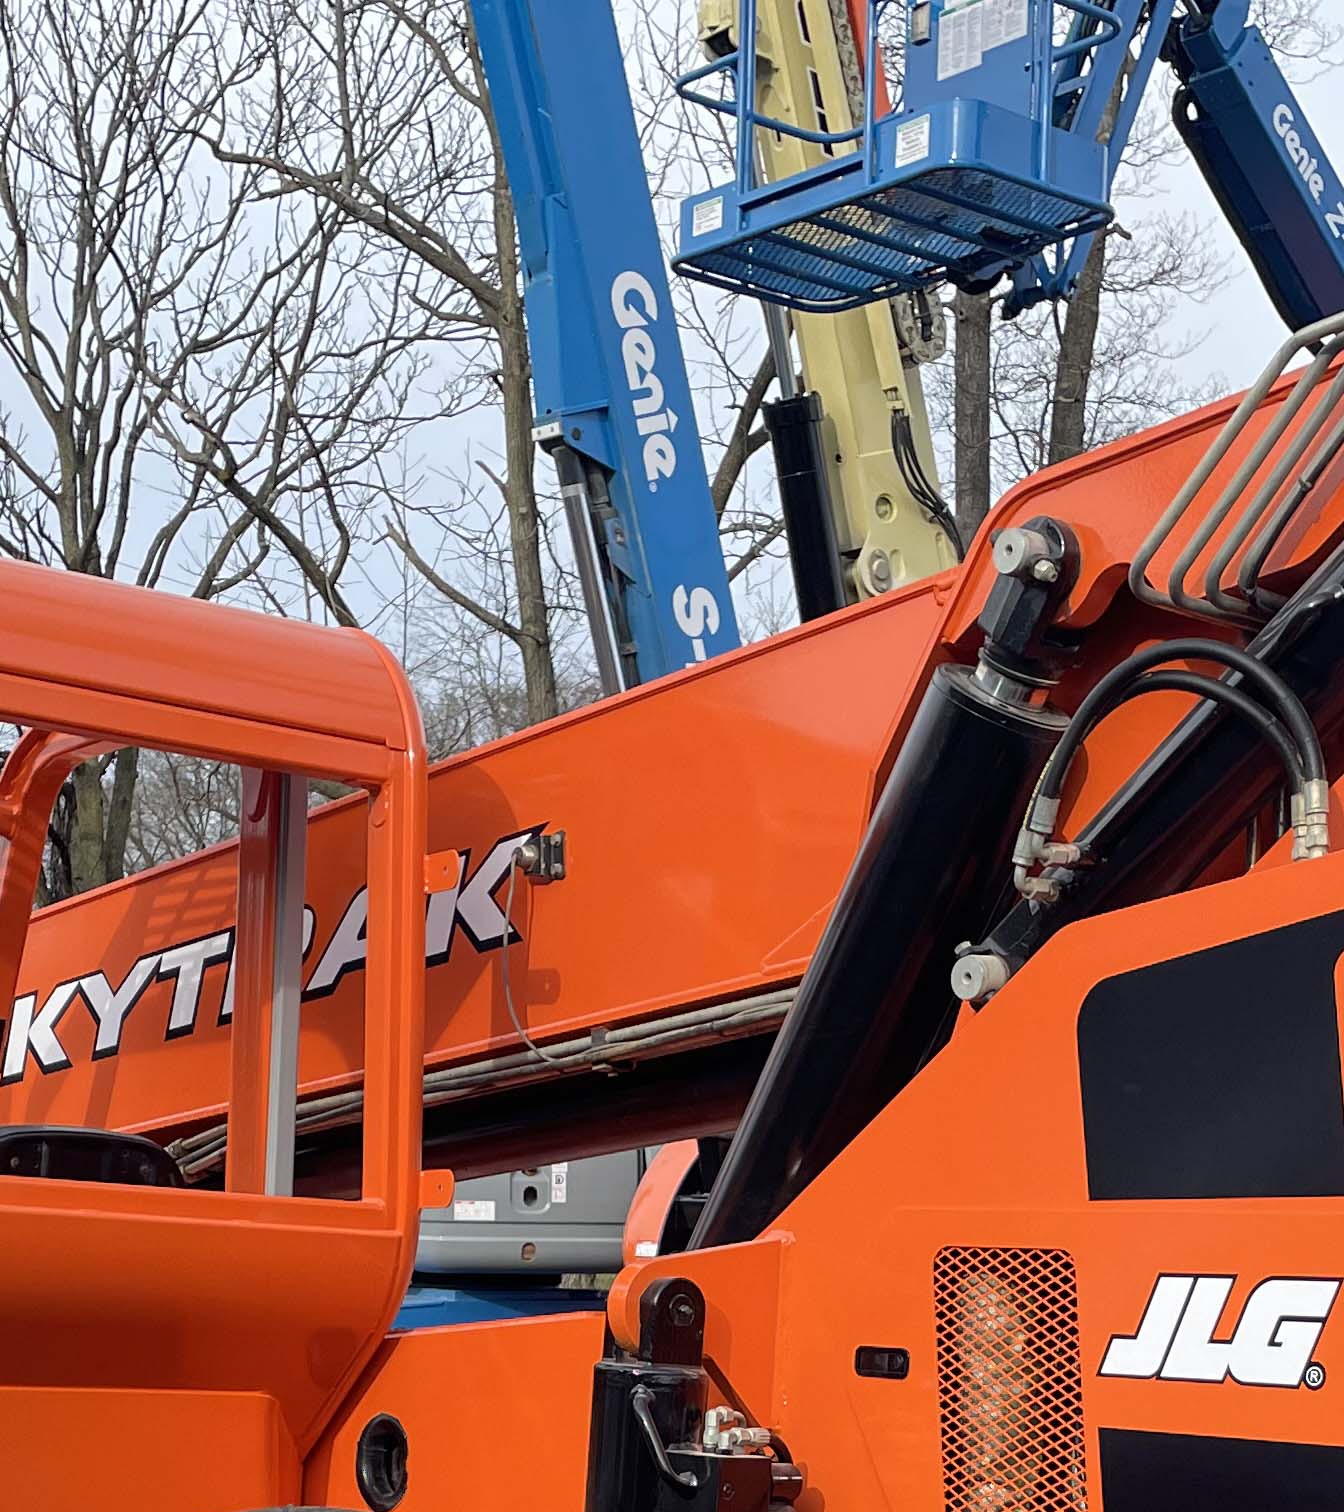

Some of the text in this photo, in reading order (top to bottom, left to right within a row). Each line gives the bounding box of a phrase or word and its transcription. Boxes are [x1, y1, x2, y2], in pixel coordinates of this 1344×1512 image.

[1272, 103, 1325, 205] Genie
[611, 270, 679, 494] Genie
[672, 584, 720, 669] S-
